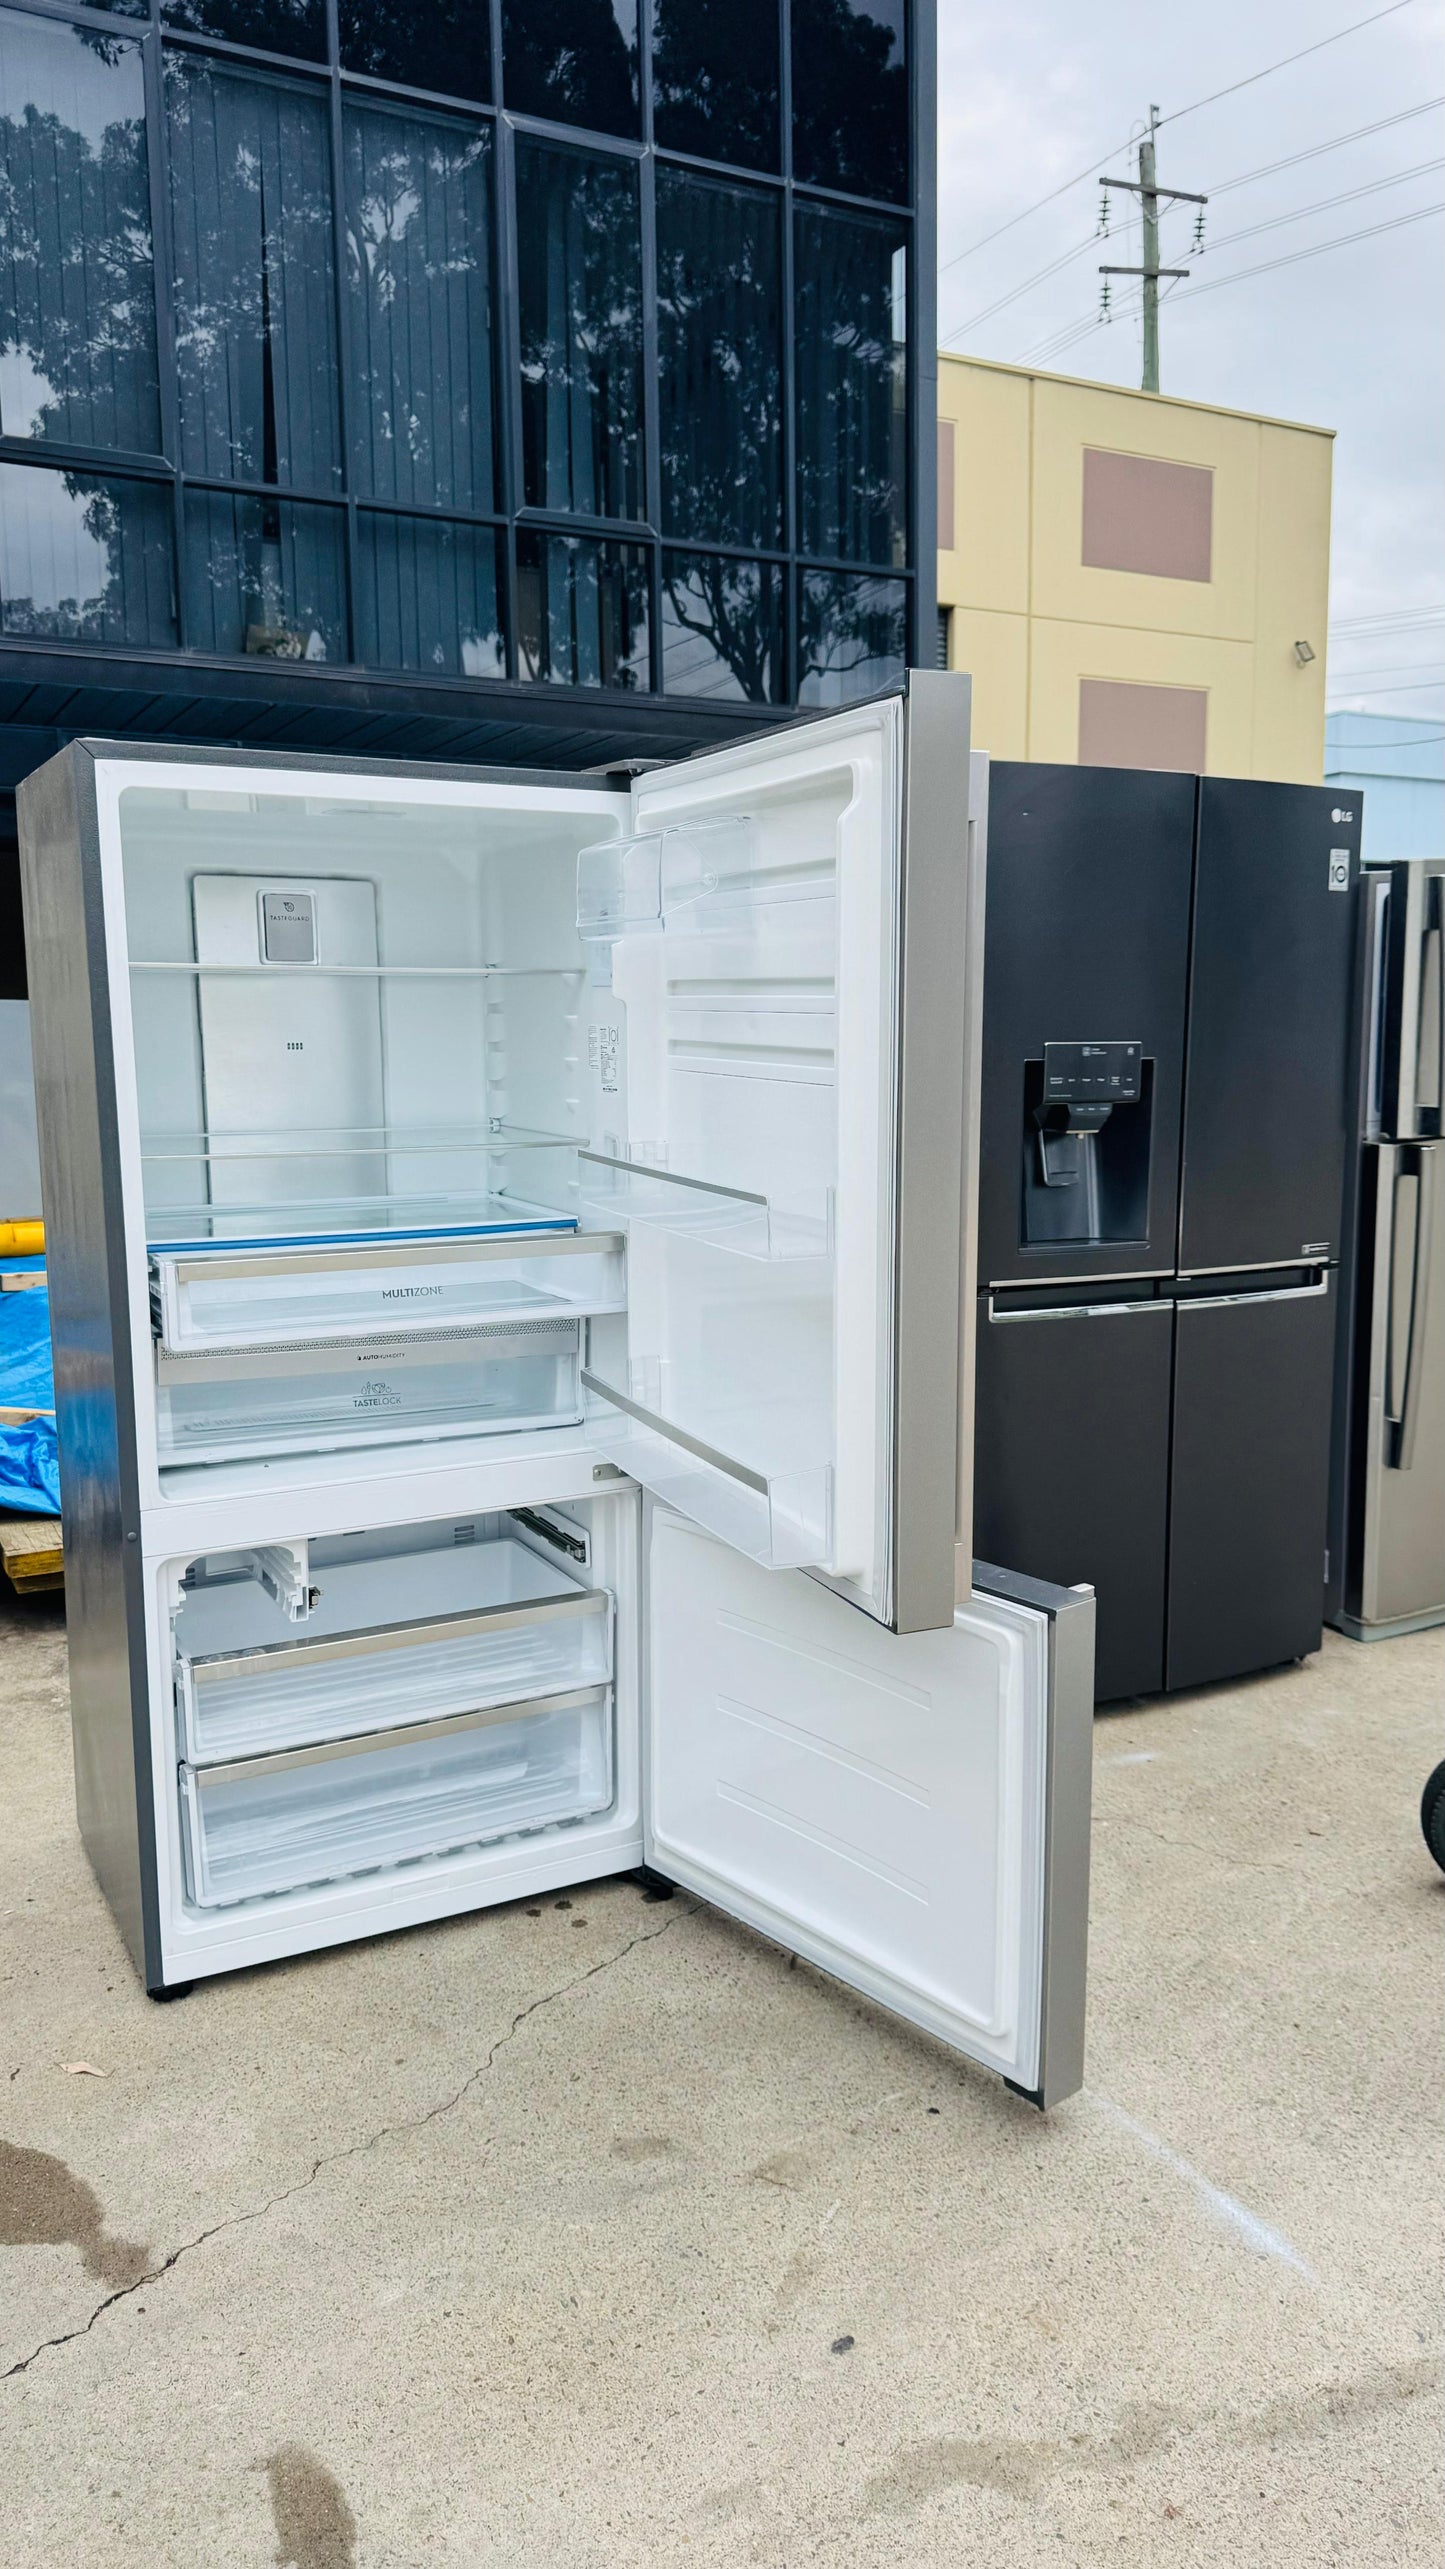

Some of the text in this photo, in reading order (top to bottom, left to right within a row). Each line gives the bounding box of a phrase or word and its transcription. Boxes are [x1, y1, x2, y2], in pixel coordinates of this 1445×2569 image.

[1341, 811, 1353, 822] LG
[382, 1285, 444, 1299] MULTIZONE
[352, 1397, 401, 1407] TASTELOCK
